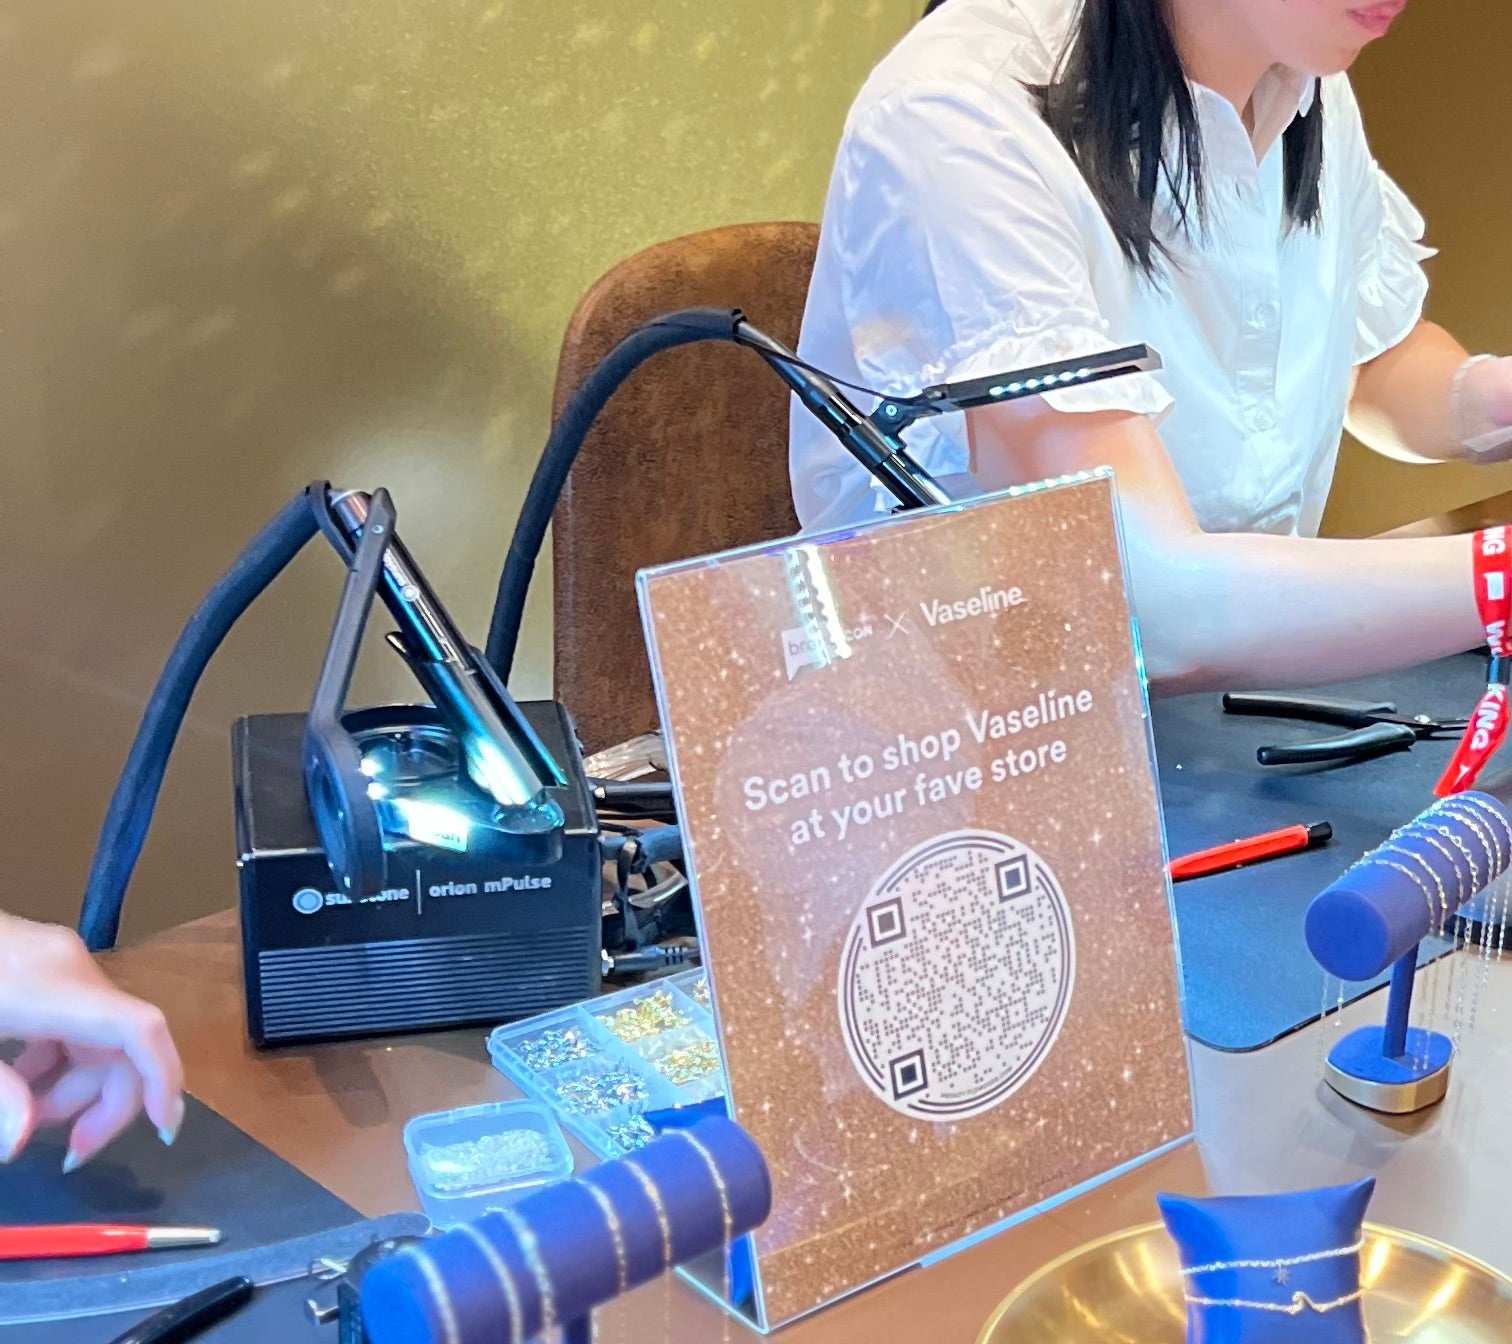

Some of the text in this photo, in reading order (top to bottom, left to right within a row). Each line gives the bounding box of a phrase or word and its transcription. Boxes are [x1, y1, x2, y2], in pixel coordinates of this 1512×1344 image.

[920, 586, 1024, 627] Vaseline
[743, 688, 1094, 811] Scan to shop Vaseline
[790, 740, 1068, 845] at your fave store
[429, 880, 478, 898] orion
[484, 874, 552, 893] mPulse
